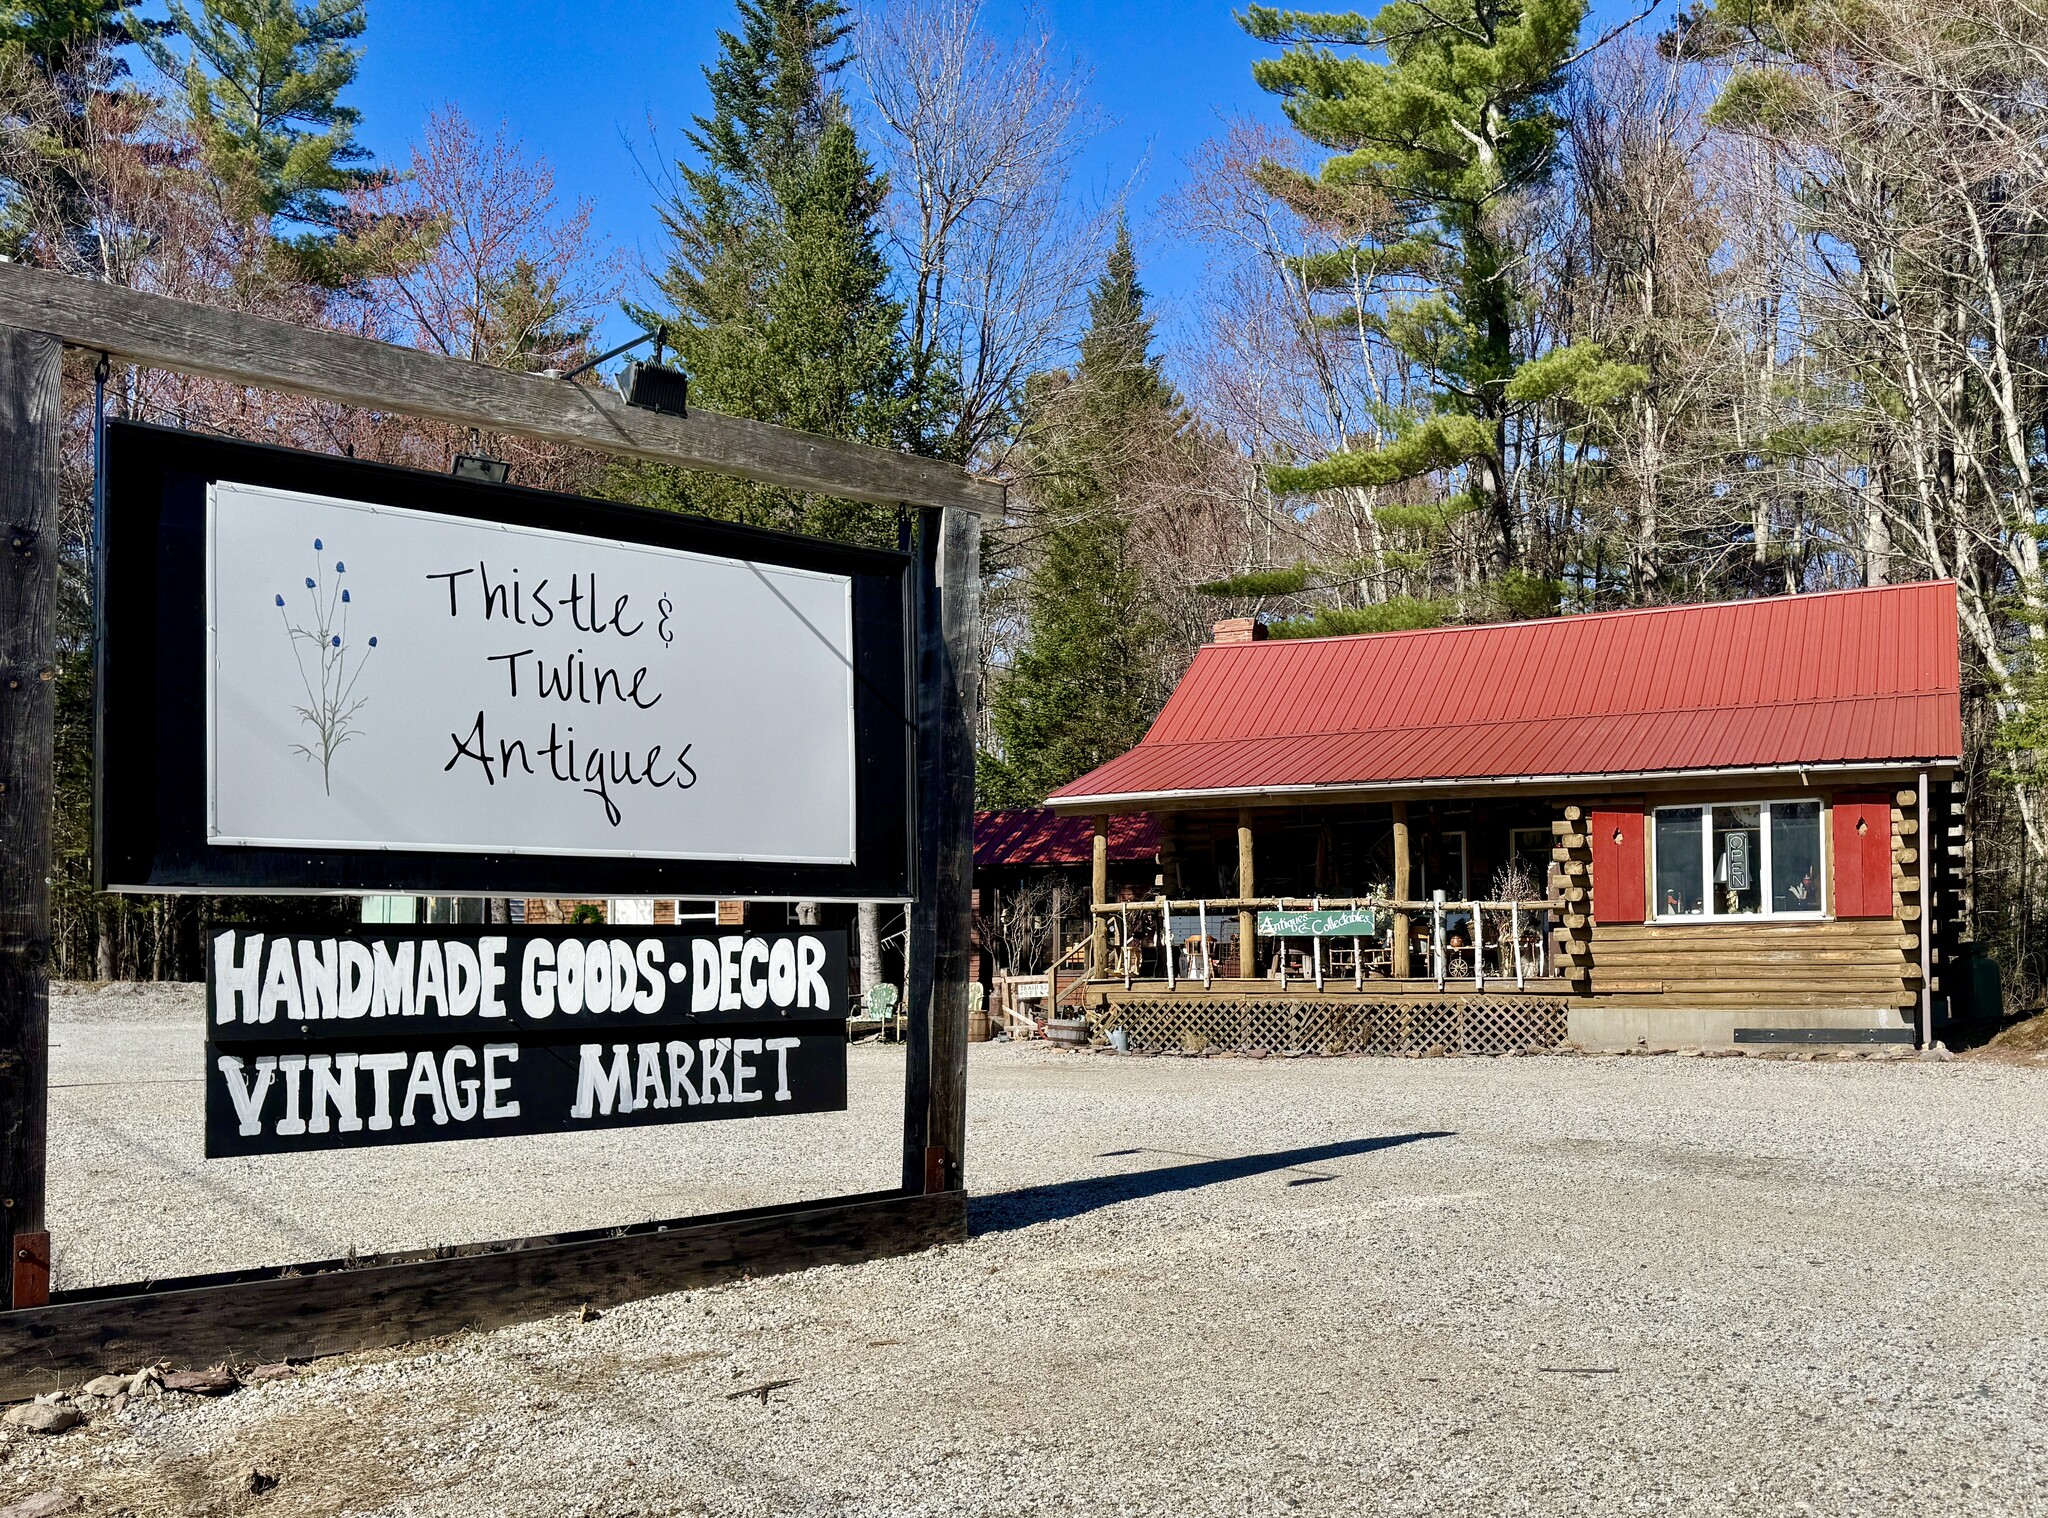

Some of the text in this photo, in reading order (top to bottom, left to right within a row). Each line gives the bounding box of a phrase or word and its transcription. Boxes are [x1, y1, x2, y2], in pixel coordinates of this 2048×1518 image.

[426, 560, 674, 648] Thistle &
[487, 649, 662, 709] Twine
[444, 711, 698, 827] Antiques
[1730, 836, 1744, 887] OPEN
[1260, 914, 1308, 933] Antiques
[1312, 911, 1371, 934] Collectables
[214, 929, 831, 1025] HANDMADE GOODS DECOR
[217, 1036, 801, 1136] VINTAGE MARKET
